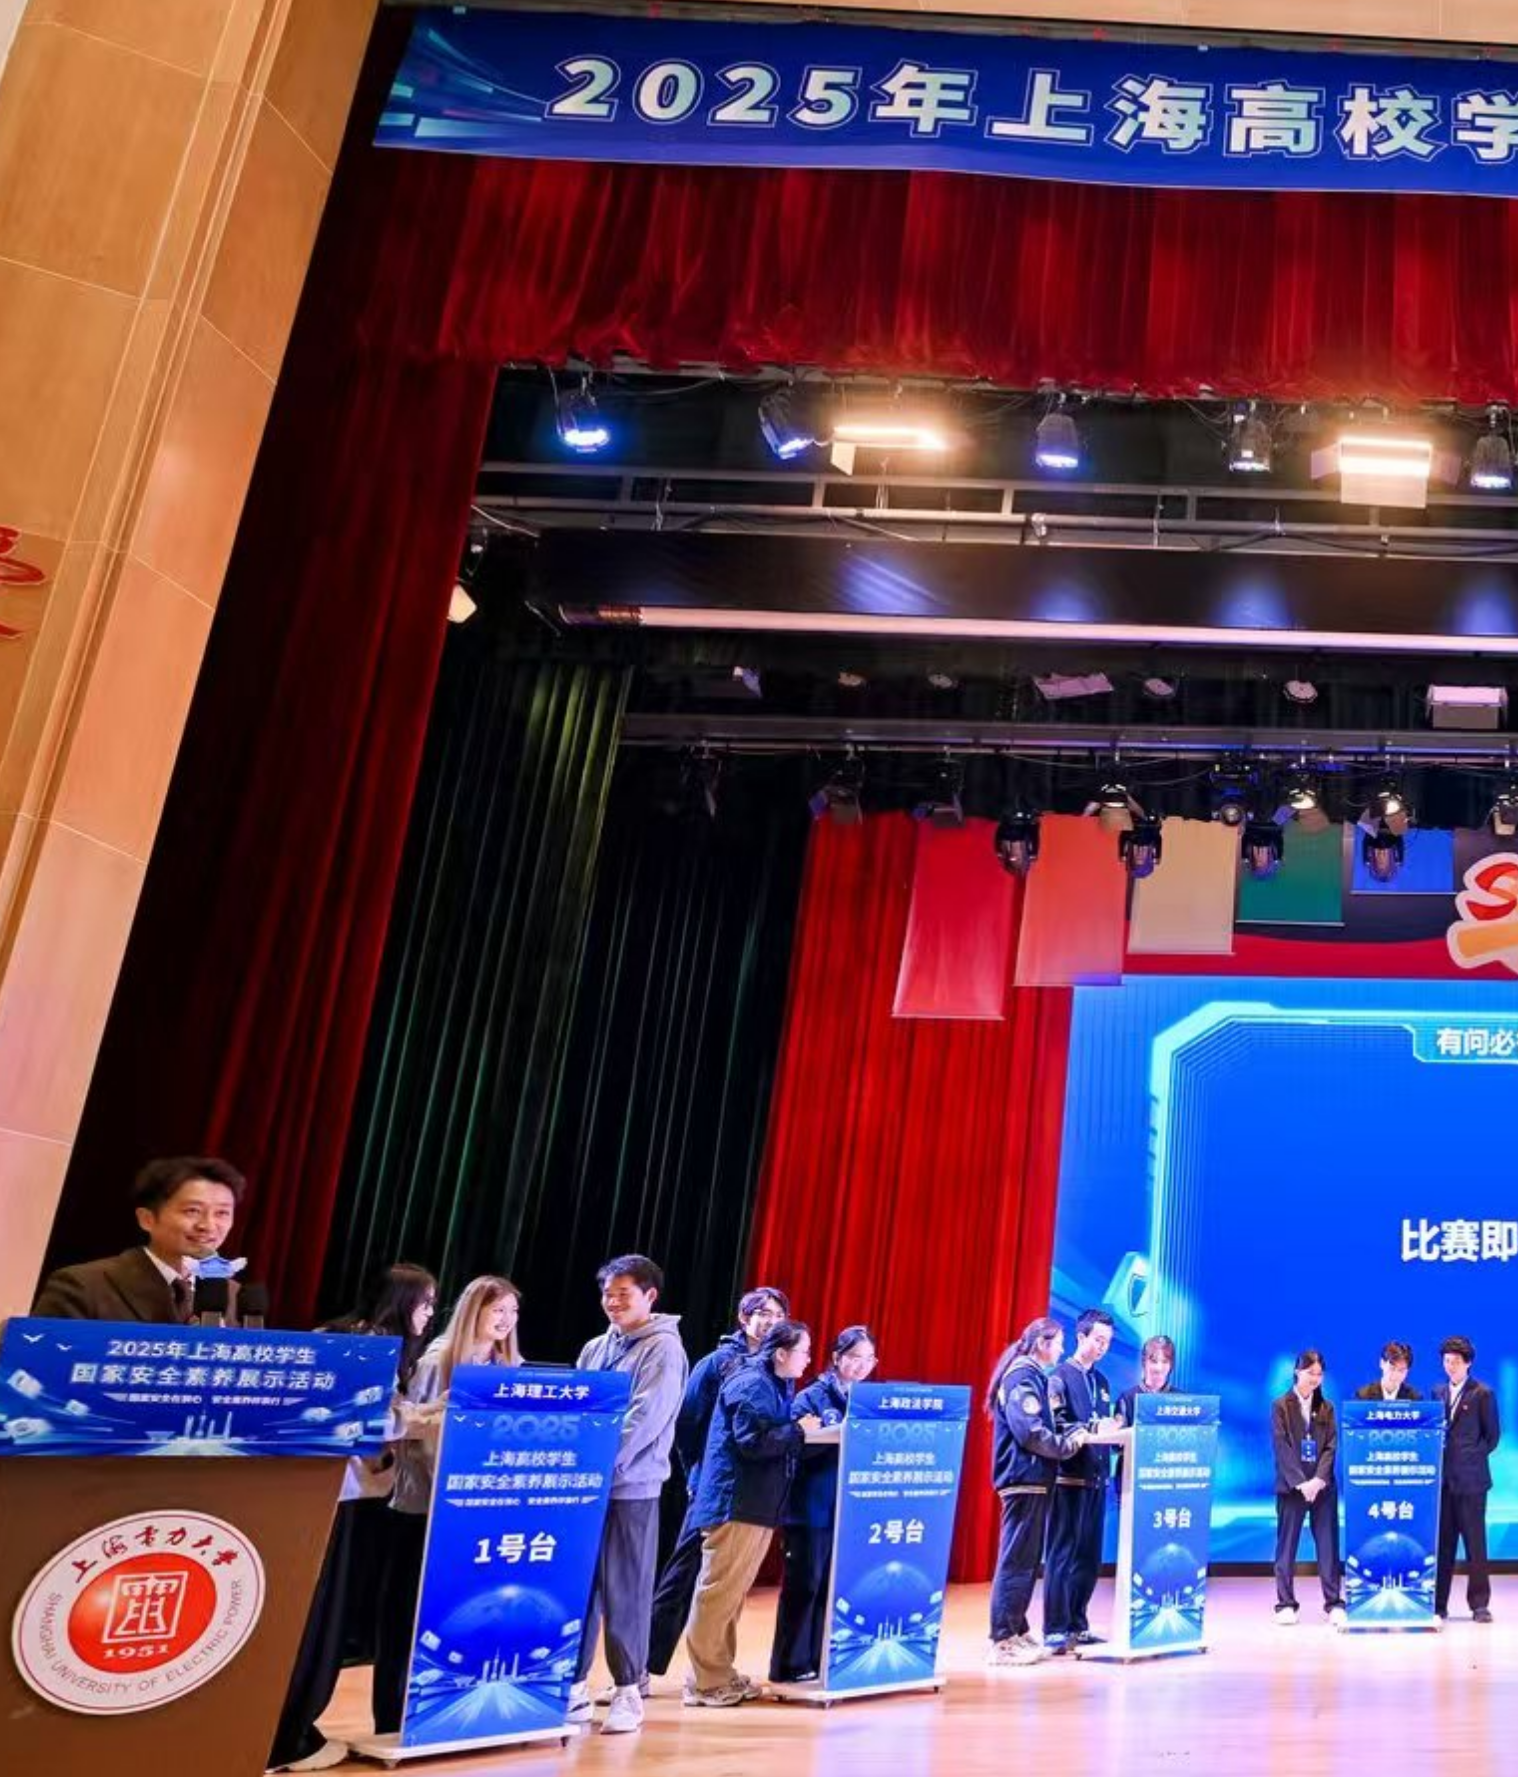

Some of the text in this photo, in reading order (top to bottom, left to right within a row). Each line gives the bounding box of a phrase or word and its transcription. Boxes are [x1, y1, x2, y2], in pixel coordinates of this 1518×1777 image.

[106, 1339, 317, 1366] 2025年上海高校学生
[70, 1362, 336, 1391] 国家安全素养展示活动
[493, 1383, 590, 1401] 上海理工大学
[878, 1397, 944, 1411] 上海政法学院
[1366, 1410, 1420, 1421] 上海电力大学
[489, 1414, 582, 1442] 2025
[482, 1450, 577, 1467] 上海高校学生
[446, 1473, 604, 1492] 国家安全素养展示活动
[1153, 1508, 1192, 1529] 3号台
[1367, 1501, 1414, 1521] 4号台
[869, 1519, 925, 1544] 2号台
[473, 1531, 558, 1565] 1号台
[37, 1579, 243, 1695] SHANGHAI UNIVERSITY OF ELECTRIC POWER
[102, 1643, 170, 1660] 1951
